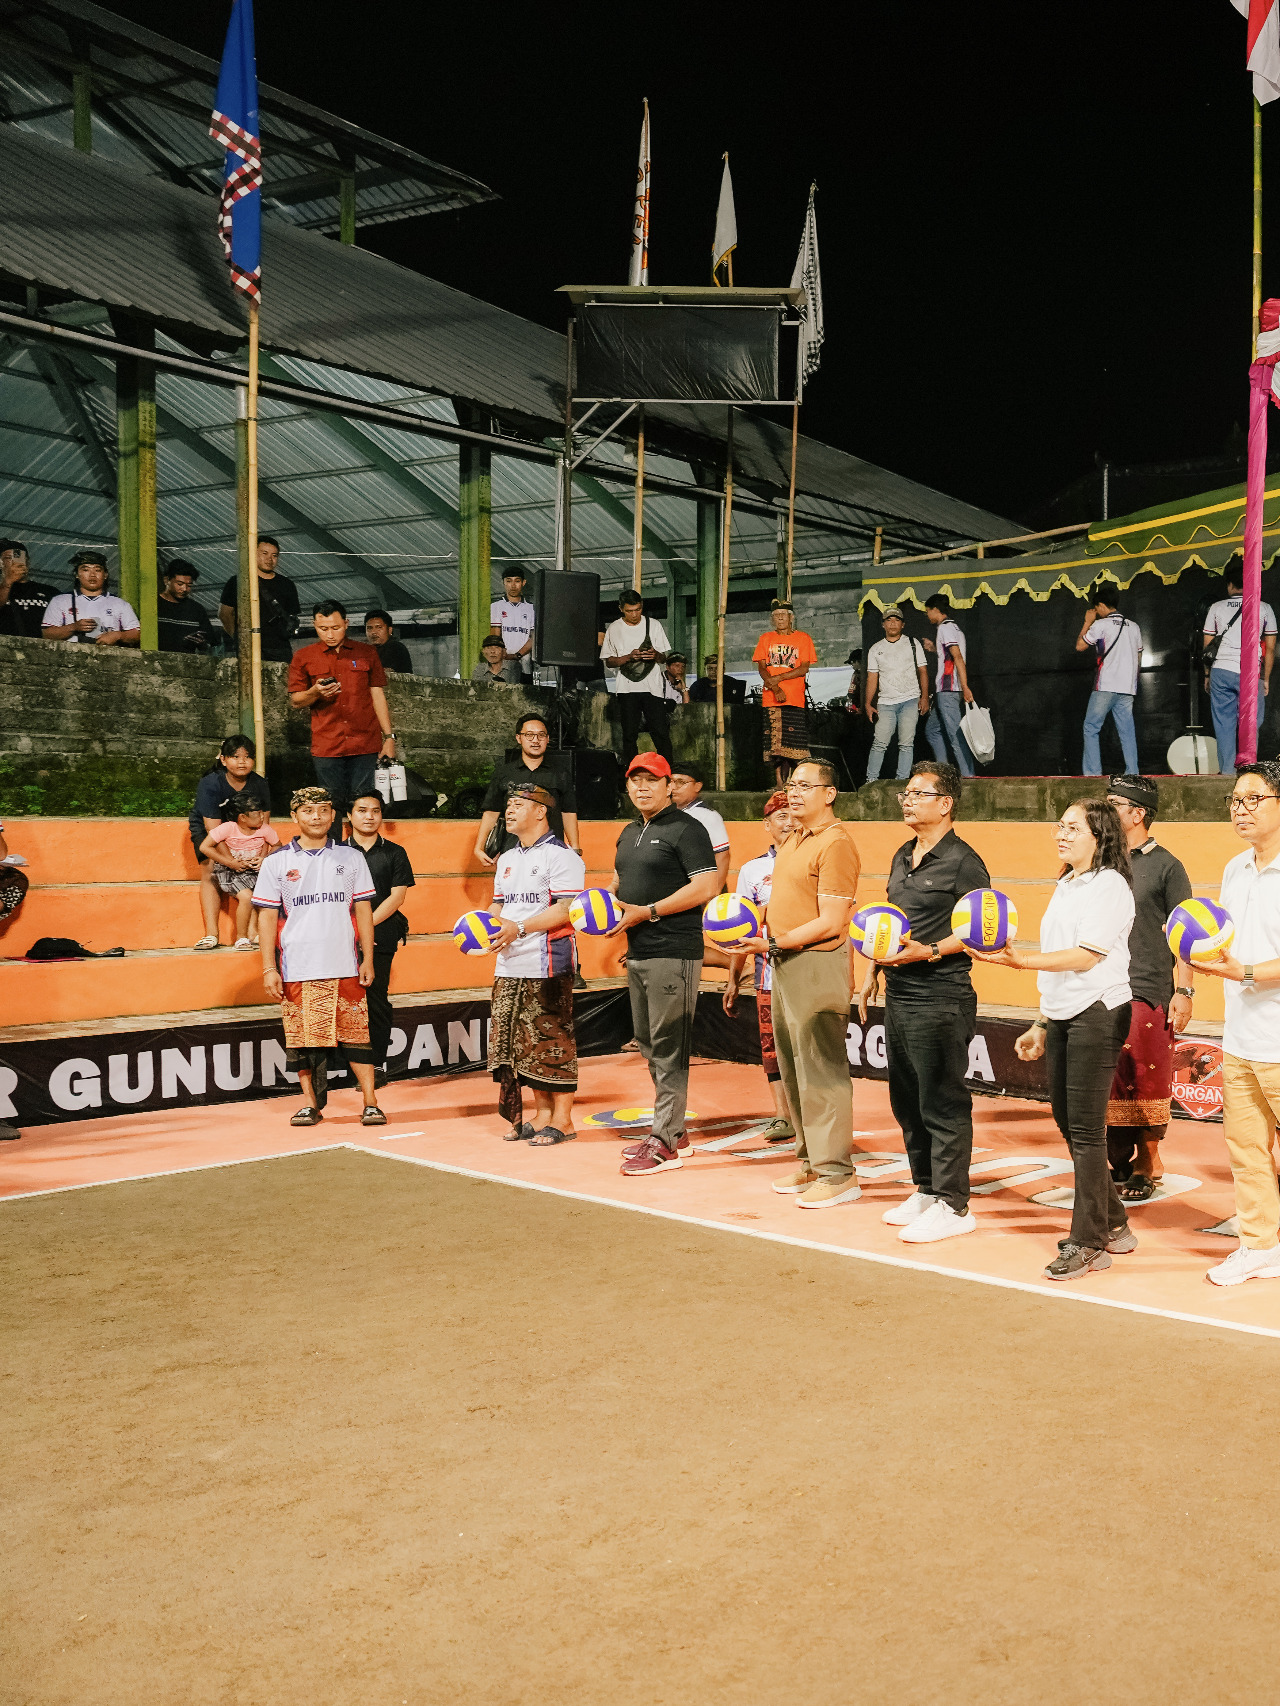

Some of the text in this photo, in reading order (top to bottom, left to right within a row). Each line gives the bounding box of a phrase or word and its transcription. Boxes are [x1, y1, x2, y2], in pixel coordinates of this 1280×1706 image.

[322, 891, 345, 903] PAND
[49, 1038, 348, 1112] GUNUN
[386, 1017, 492, 1072] PAN
[1172, 1084, 1223, 1103] ORGAN
